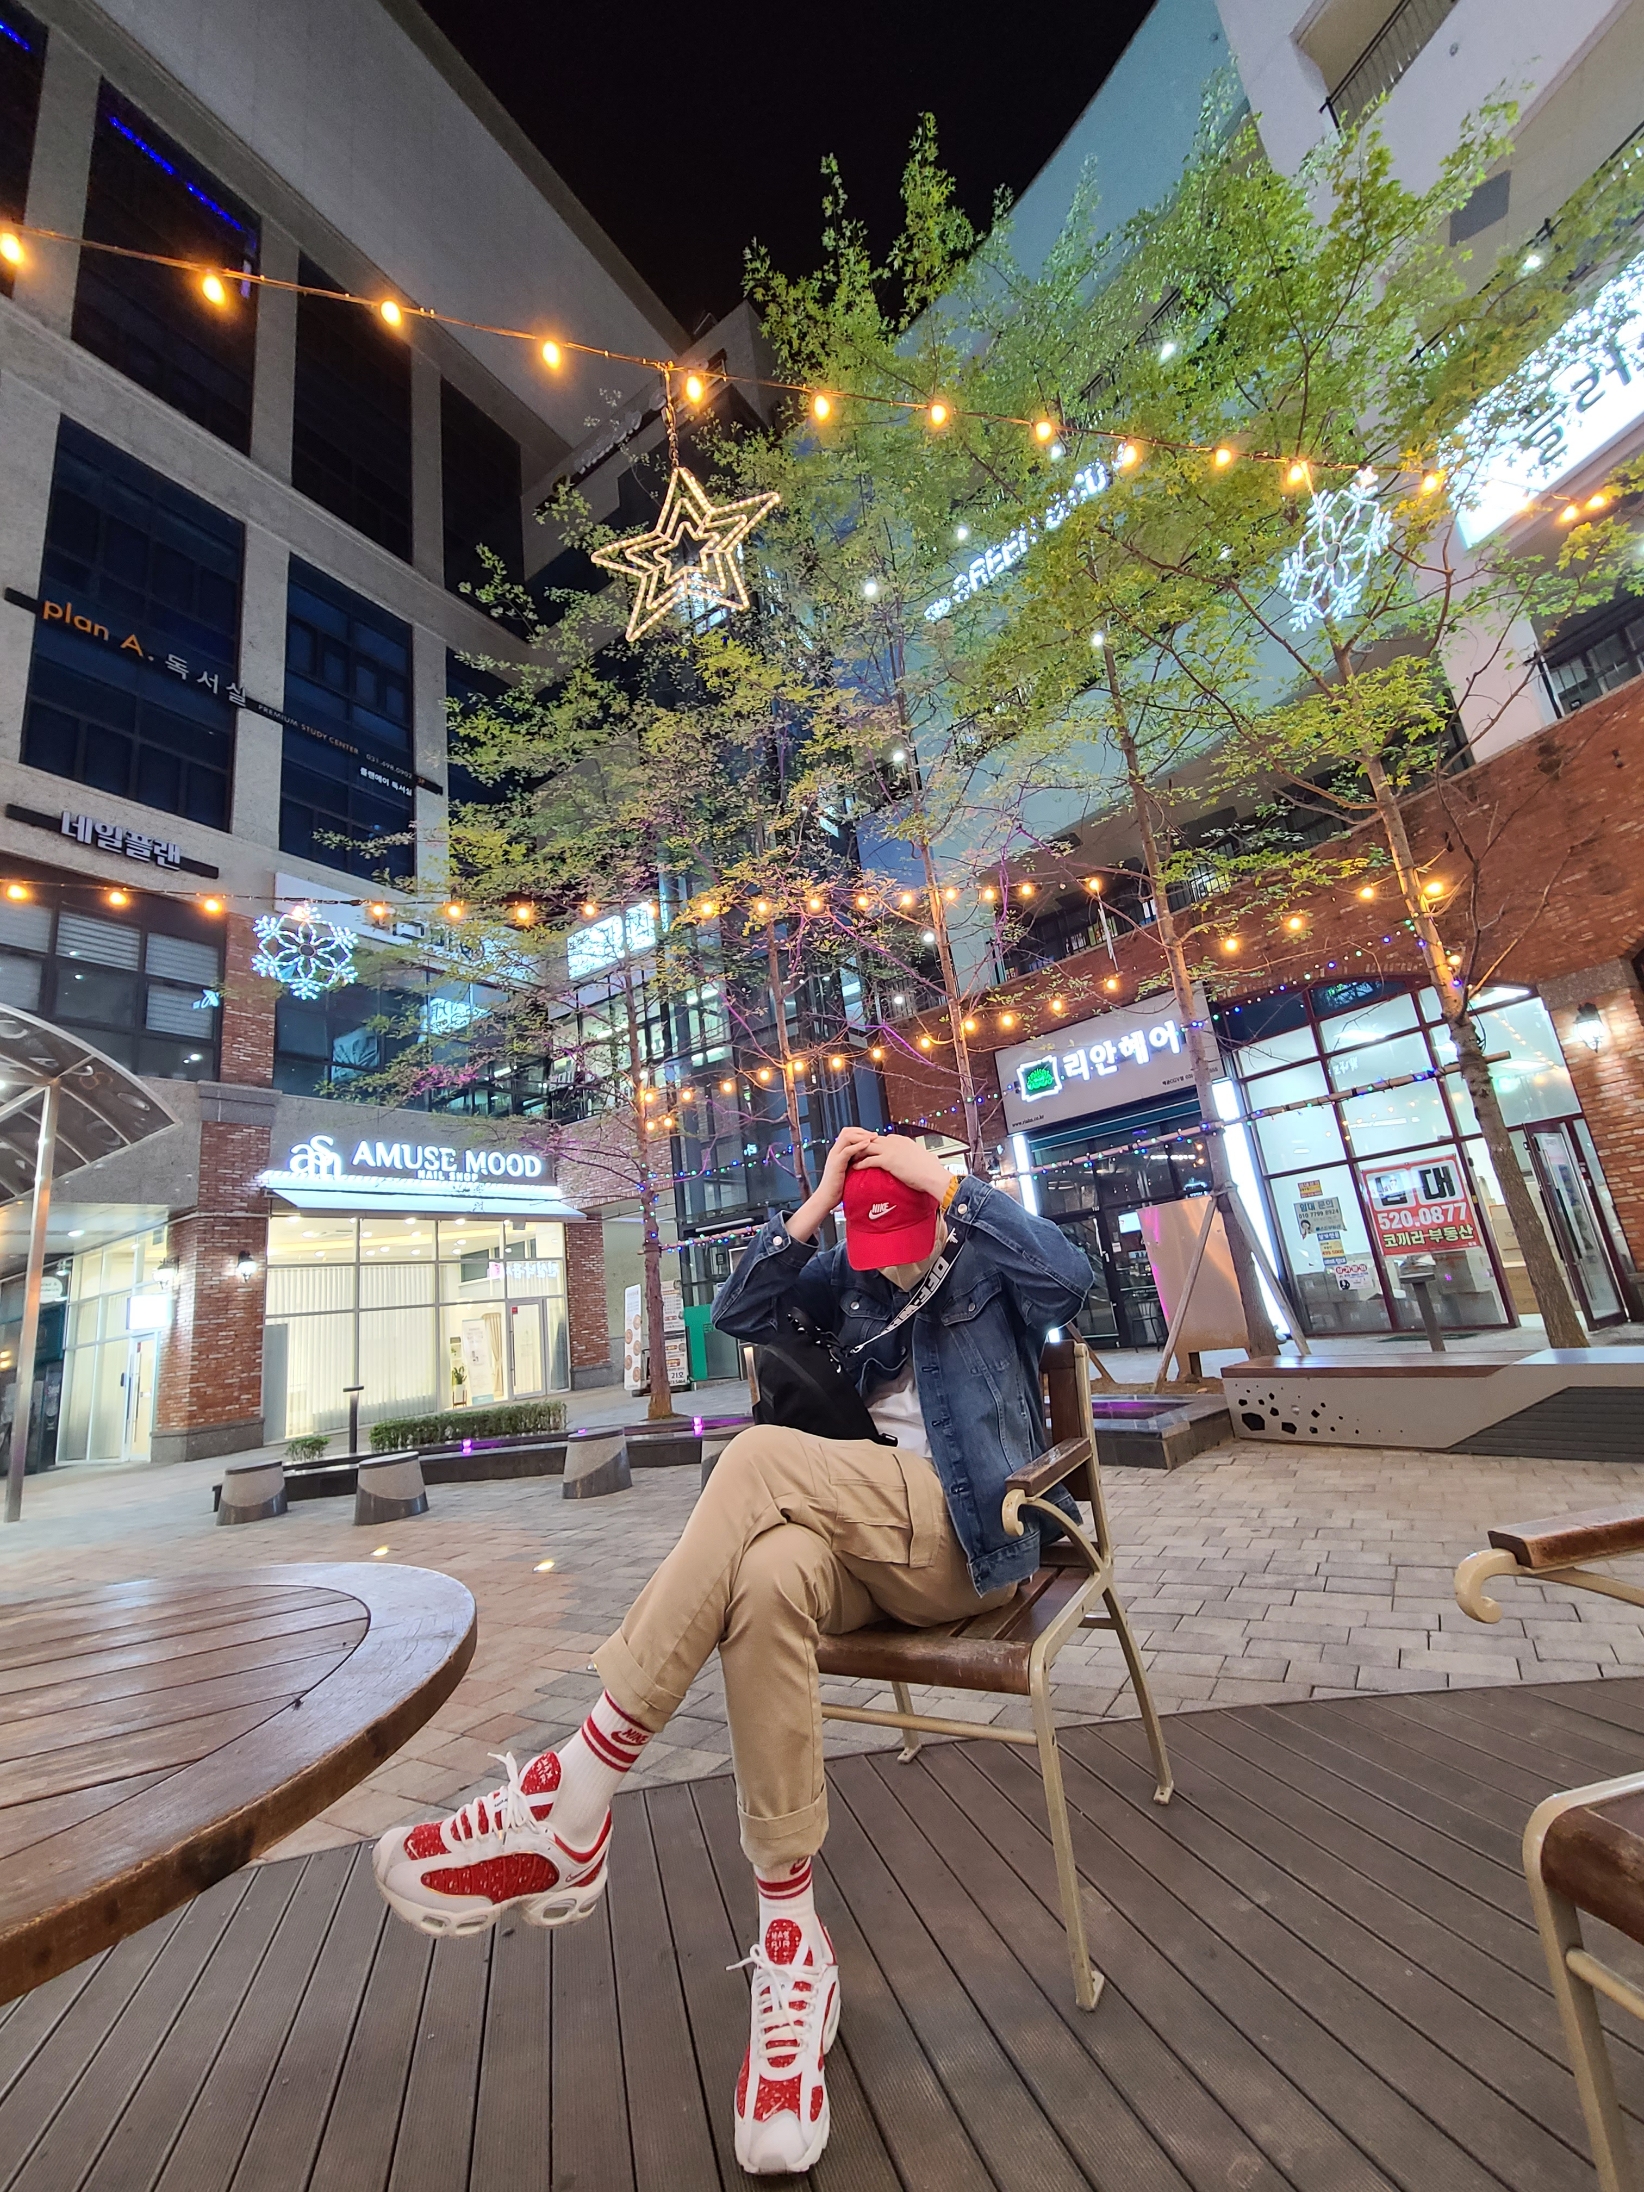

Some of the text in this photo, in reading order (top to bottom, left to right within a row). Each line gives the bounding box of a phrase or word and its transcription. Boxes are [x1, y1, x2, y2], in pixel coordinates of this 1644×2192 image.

[43, 600, 110, 641] plan
[165, 653, 247, 708] 독서실
[258, 704, 299, 727] PREMIUM
[301, 724, 328, 740] STUDY
[328, 735, 359, 755] CENTER
[61, 810, 182, 872] 네일플랜
[1063, 1019, 1181, 1081] 리안헤어
[352, 1140, 458, 1172] AMUSE
[465, 1149, 542, 1178] MOOD
[417, 1169, 479, 1183] NAIL SHOP
[871, 1201, 890, 1215] NIKE
[1377, 1201, 1468, 1231] 520.0877
[1427, 1223, 1475, 1244] 부동산
[622, 1728, 650, 1744] NIKE
